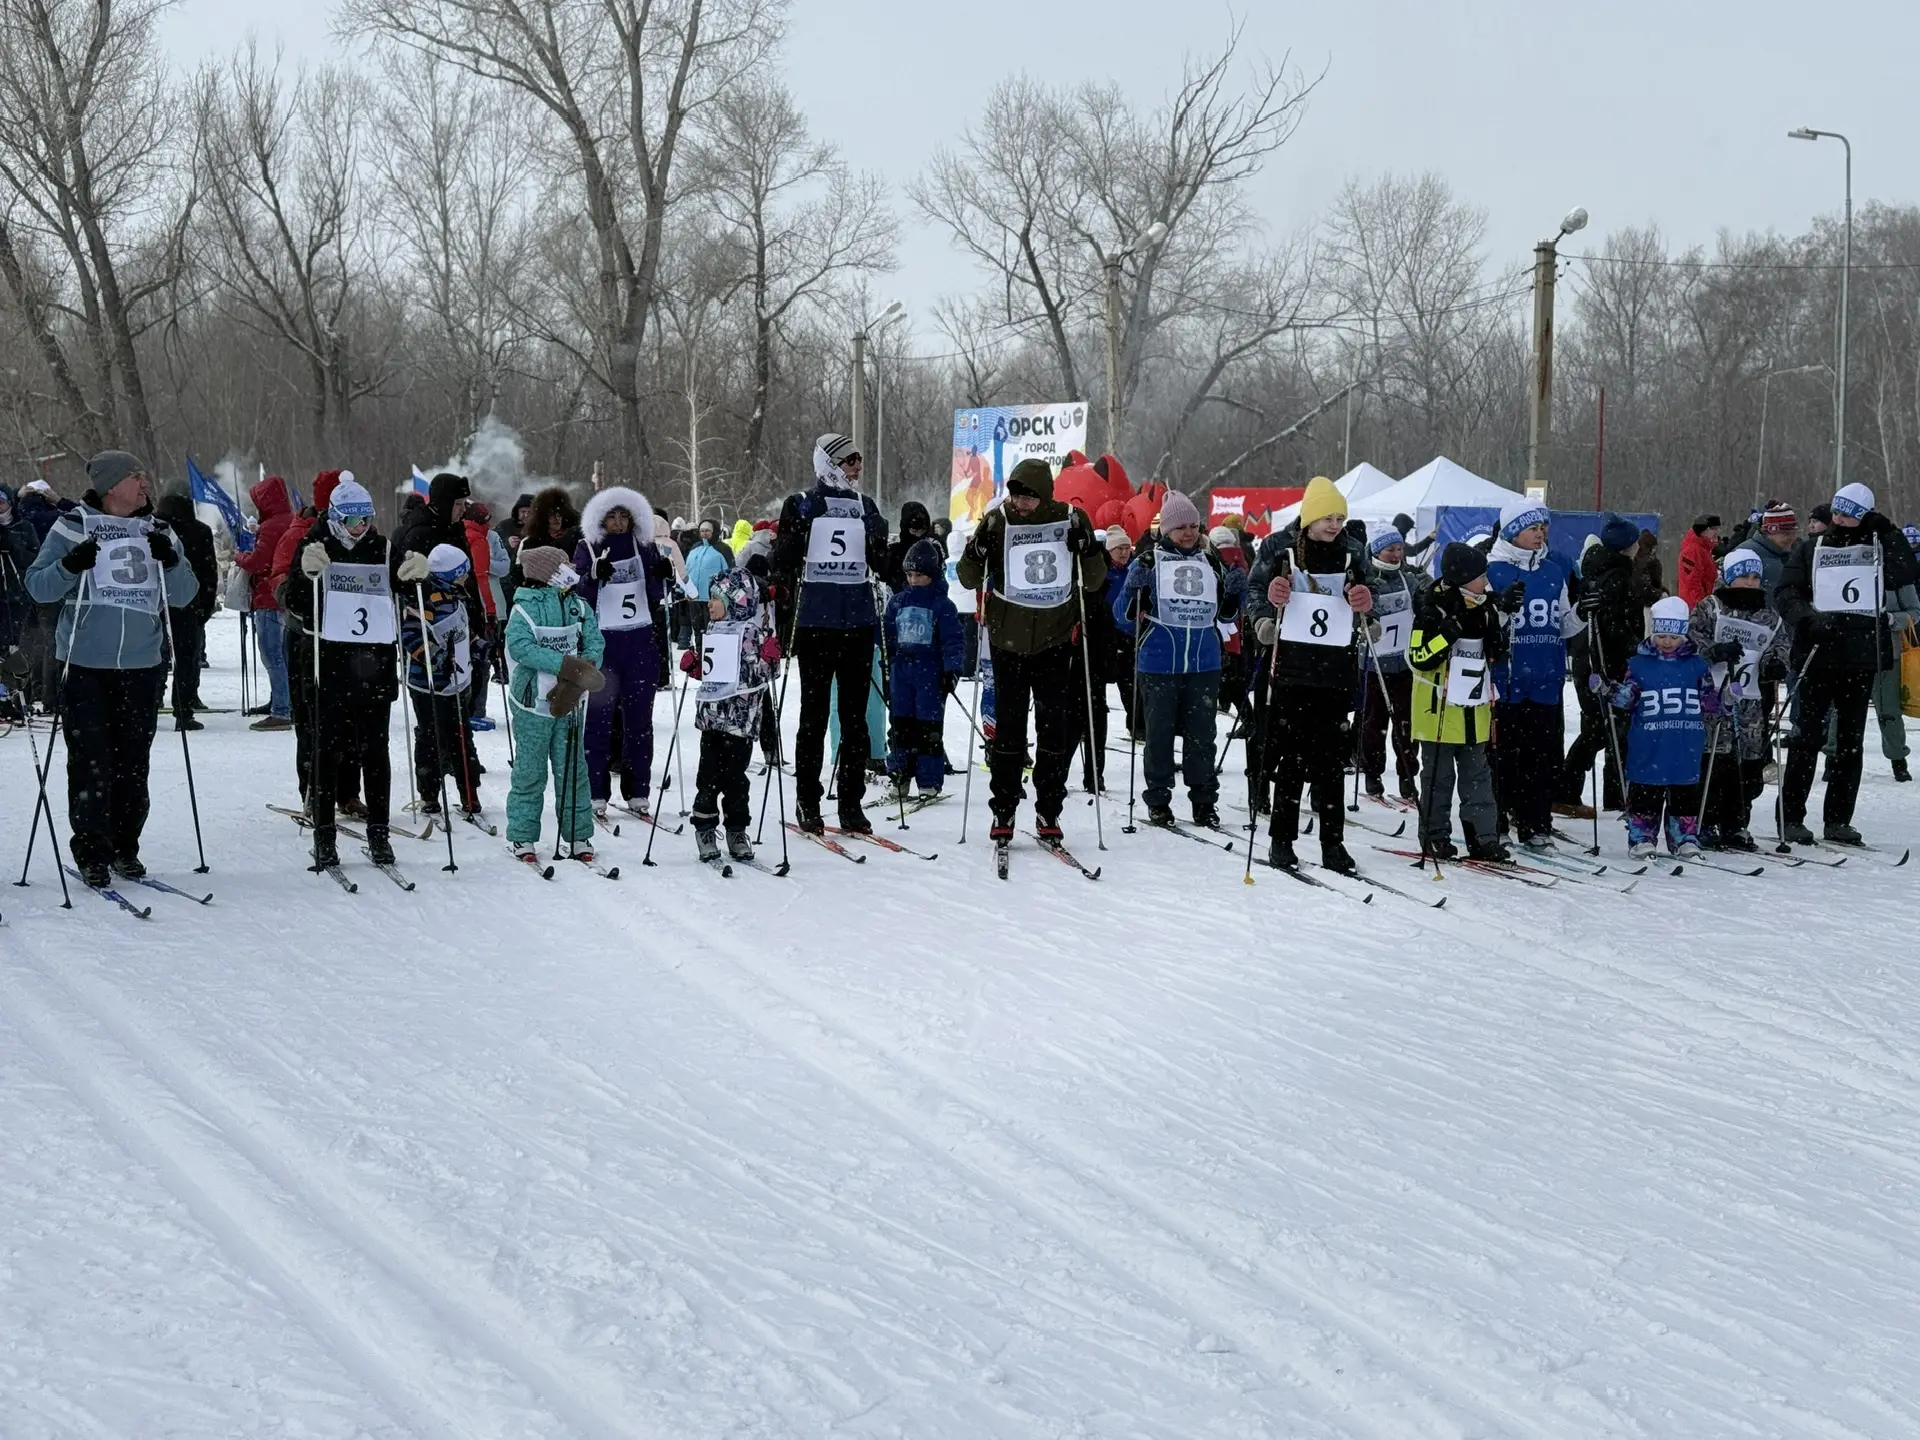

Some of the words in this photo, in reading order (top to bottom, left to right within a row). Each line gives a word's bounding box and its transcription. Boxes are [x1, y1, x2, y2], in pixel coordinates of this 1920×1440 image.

[1008, 416, 1055, 437] ОРСК
[1025, 442, 1056, 454] ГОРОД
[831, 530, 846, 556] 5
[1012, 531, 1043, 541] ЛЫЖНЯ
[109, 546, 148, 584] 3
[330, 573, 357, 583] КРОСС
[1024, 549, 1057, 585] 8
[330, 582, 364, 592] НАЦИИ
[1173, 565, 1204, 597] 8
[1842, 577, 1860, 604] 6
[622, 594, 637, 619] 5
[351, 607, 369, 636] 3
[1310, 608, 1329, 637] 8
[1722, 625, 1752, 637] ЛЫЖНЯ
[1386, 624, 1399, 647] 7
[703, 647, 715, 676] 5
[1461, 666, 1486, 700] 7
[1733, 662, 1756, 688] 6
[1640, 687, 1702, 717] 355
